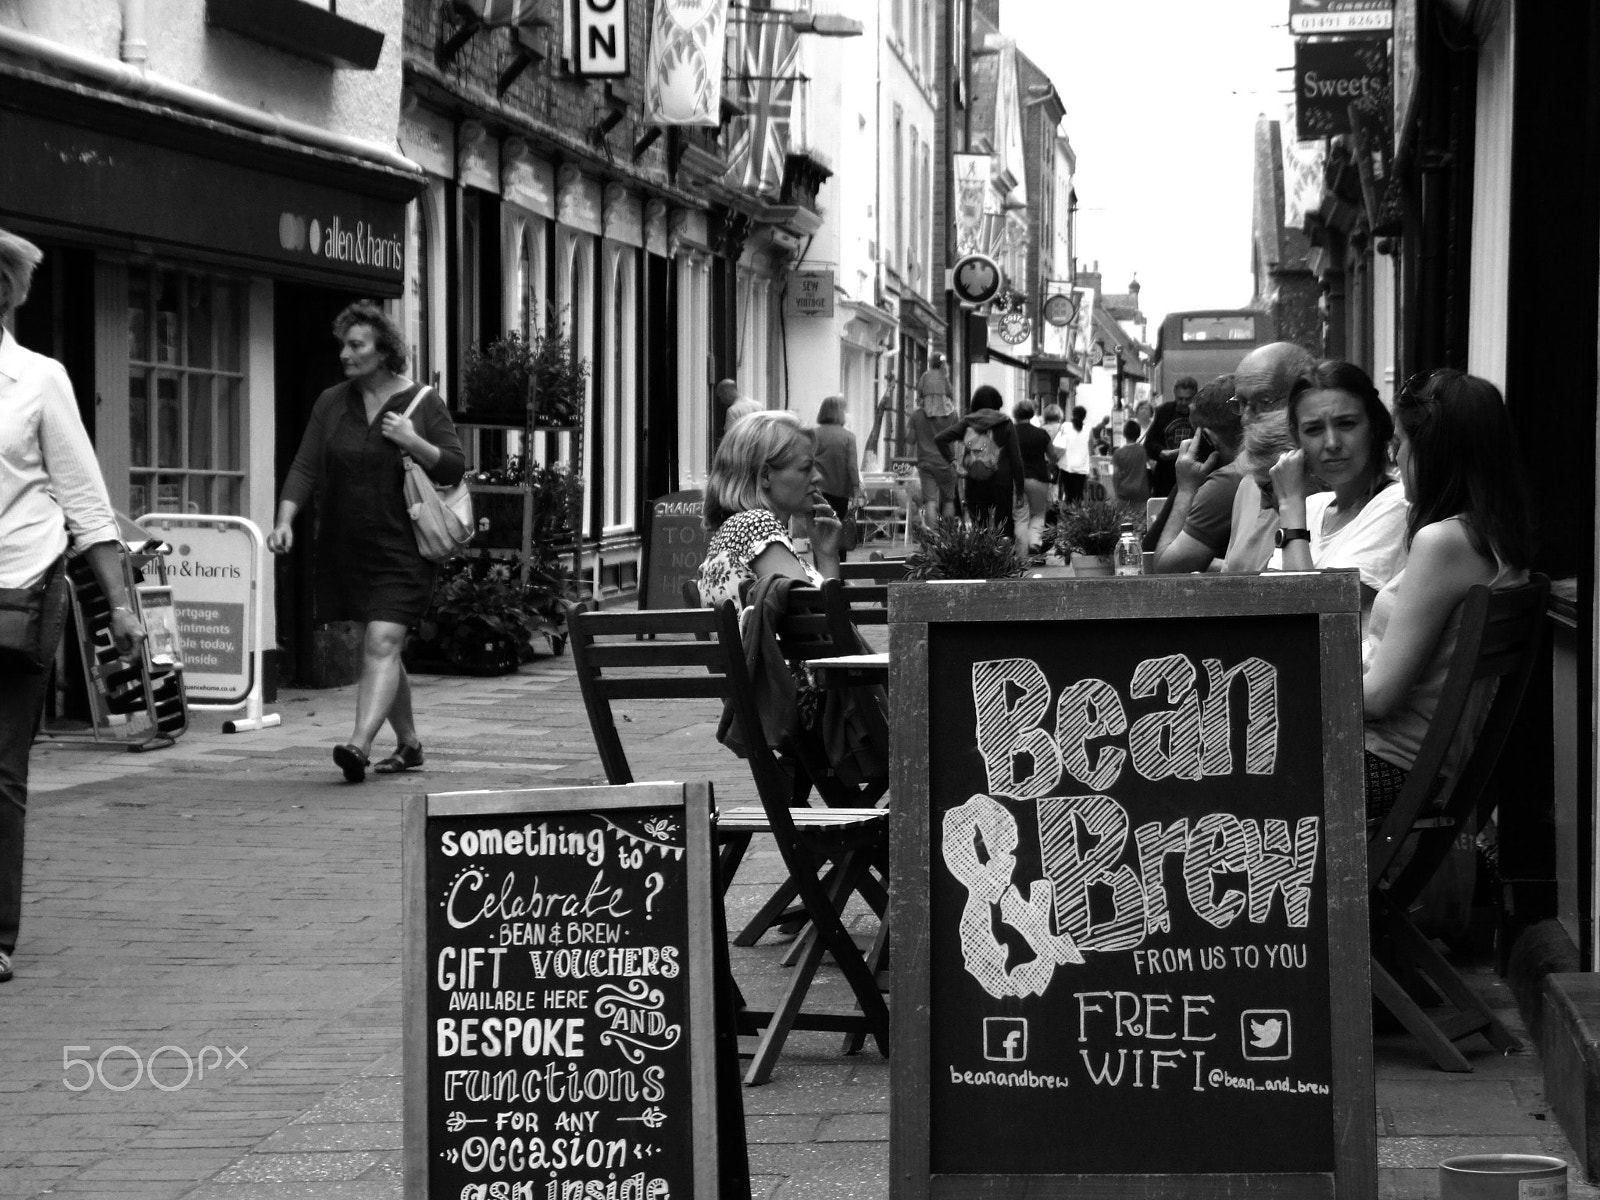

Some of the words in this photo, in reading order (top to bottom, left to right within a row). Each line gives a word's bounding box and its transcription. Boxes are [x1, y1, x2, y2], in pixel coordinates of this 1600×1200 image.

[1304, 71, 1381, 98] Sweets
[324, 215, 353, 262] allen
[355, 220, 365, 265] &
[367, 223, 401, 270] harris
[142, 560, 176, 576] alln
[180, 561, 192, 577] &
[195, 562, 241, 578] harris
[672, 551, 703, 568] NO
[174, 607, 219, 620] ortgage
[200, 637, 235, 652] today,
[184, 653, 218, 666] inside
[972, 653, 1279, 801] Bean
[440, 822, 606, 867] something
[618, 845, 643, 870] to
[1036, 795, 1320, 953] Brew
[499, 922, 546, 946] BEAN
[548, 922, 564, 946] &
[567, 923, 621, 945] BREW
[437, 946, 508, 992] GIFT
[528, 945, 681, 980] VOUCHERS
[1133, 949, 1194, 975] FROM
[1200, 947, 1226, 971] US
[1231, 946, 1259, 969] TO
[1262, 943, 1307, 969] YOU
[449, 990, 535, 1012] AVAILABLE
[544, 990, 589, 1009] HERE
[610, 1007, 667, 1036] AND
[1073, 990, 1217, 1043] FREE
[437, 1017, 585, 1058] BESPOKE
[444, 1062, 666, 1103] Functions
[950, 1065, 1070, 1090] beanandbrew
[1079, 1049, 1205, 1092] WIFI
[1208, 1069, 1330, 1096] @bean_and_brew
[495, 1111, 539, 1132] FOR
[555, 1111, 600, 1132] ANY
[461, 1132, 627, 1172] Occasion
[460, 1180, 534, 1200] ask
[545, 1171, 670, 1200] inside
